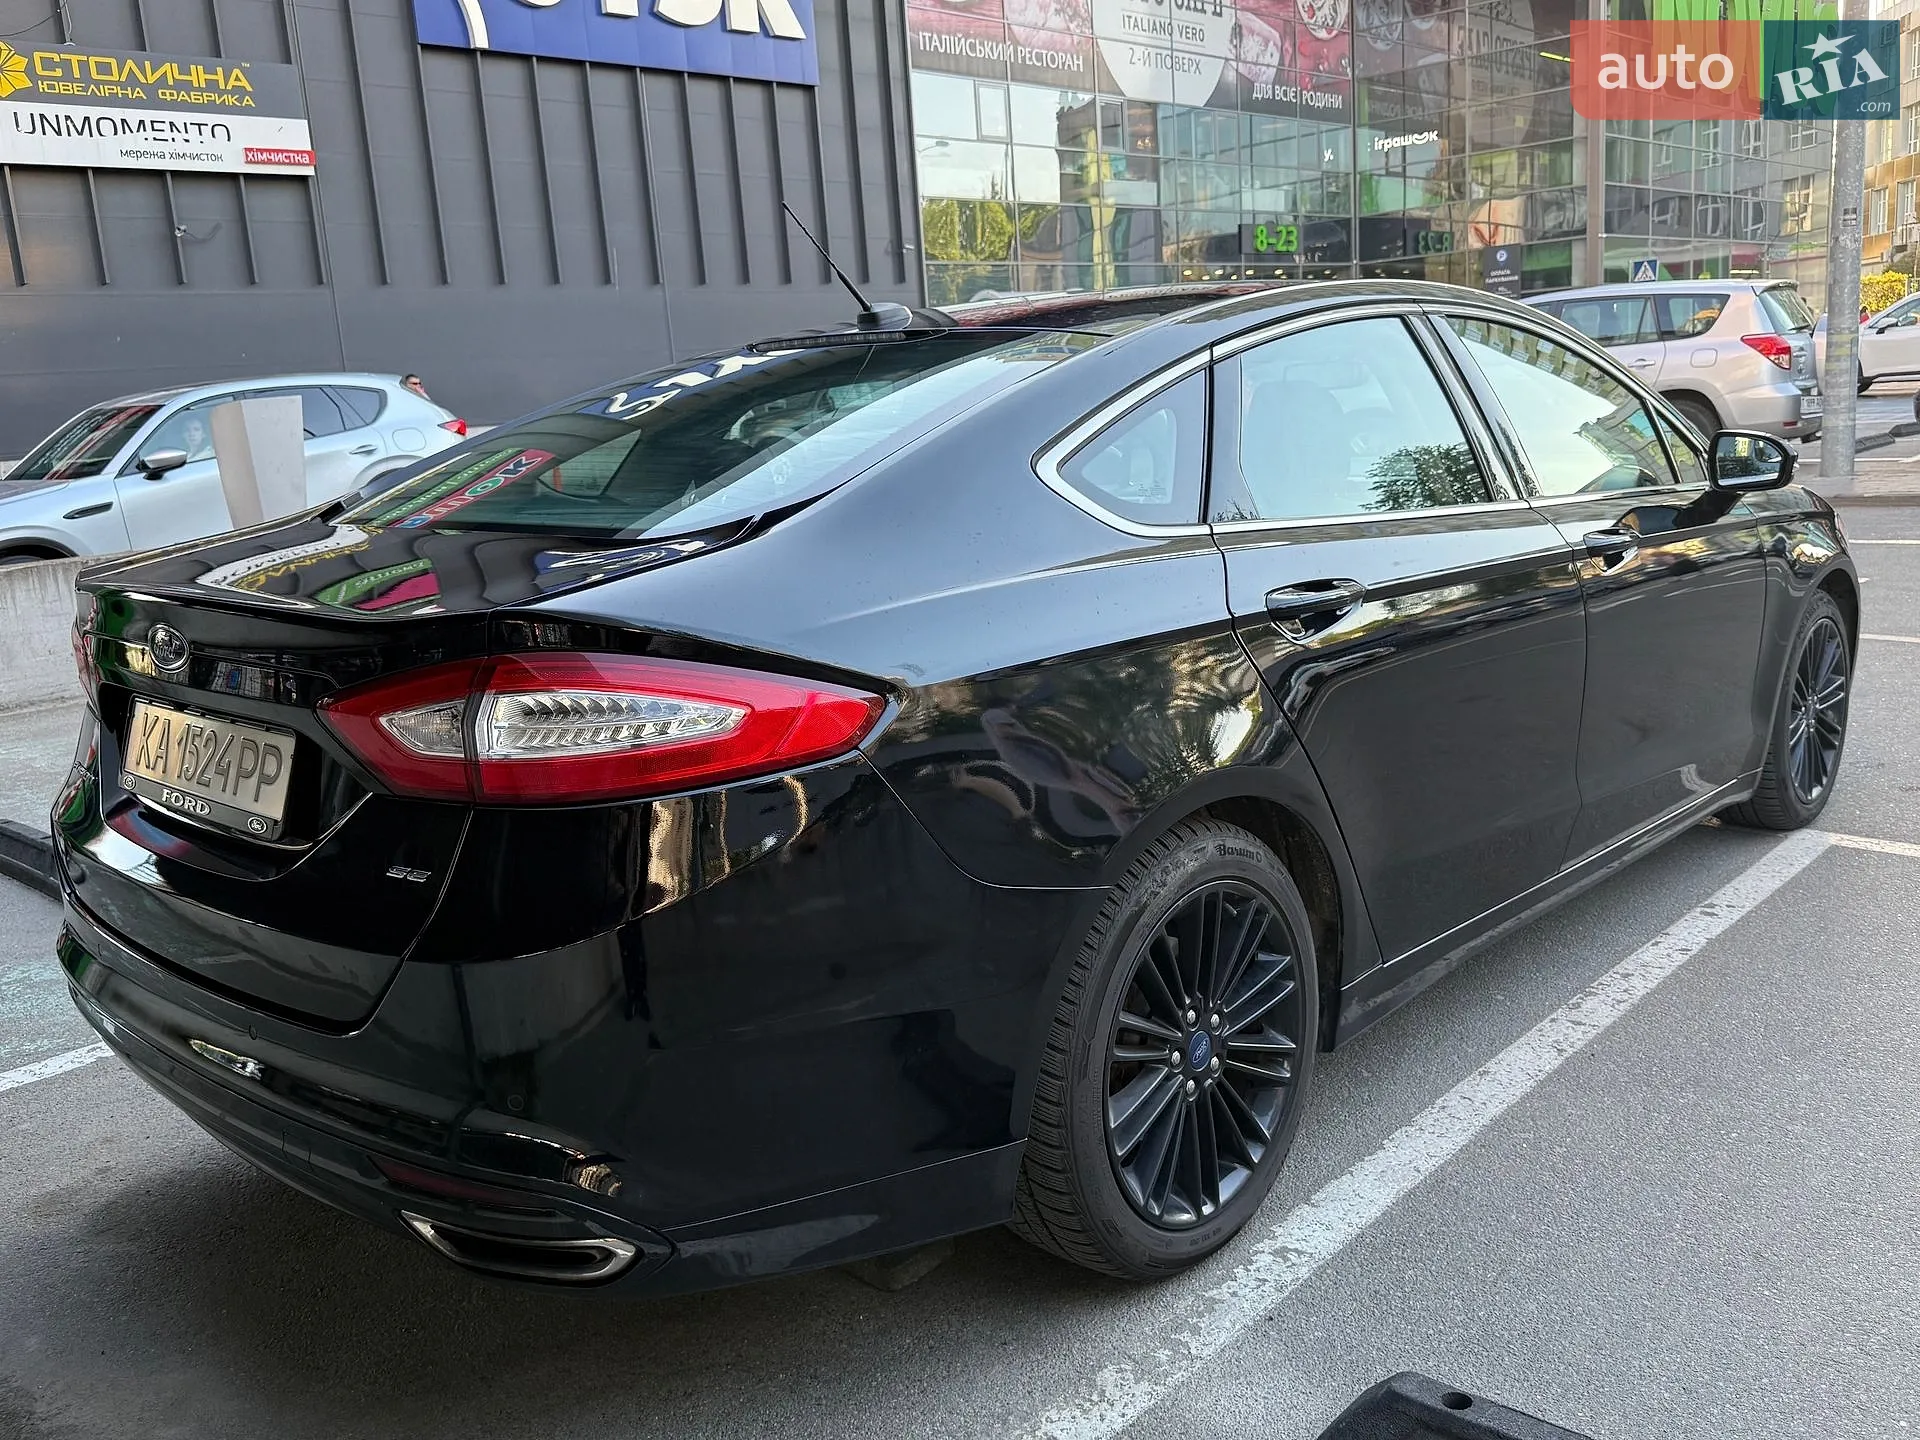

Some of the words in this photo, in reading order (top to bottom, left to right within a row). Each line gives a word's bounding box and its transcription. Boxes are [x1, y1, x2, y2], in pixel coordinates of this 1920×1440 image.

[1122, 14, 1173, 37] ITALIANO
[1176, 24, 1205, 42] VERO
[919, 32, 1014, 62] ІТАЛІЙСЬКИЙ
[1017, 46, 1084, 72] РЕСТОРАН
[1155, 52, 1202, 75] ПОВЕРХ
[33, 51, 253, 92] СТОЛИЧНА
[38, 80, 147, 99] ЮВЕЛІРНА
[158, 89, 255, 107] ФАБРИКА
[1252, 82, 1272, 100] ДЛЯ
[1302, 90, 1342, 109] РОДИНИ
[120, 149, 165, 161] мережа
[168, 149, 223, 162] хімчисток
[246, 149, 310, 163] хімчистка
[1255, 225, 1297, 252] 8-23
[161, 789, 212, 816] FORD
